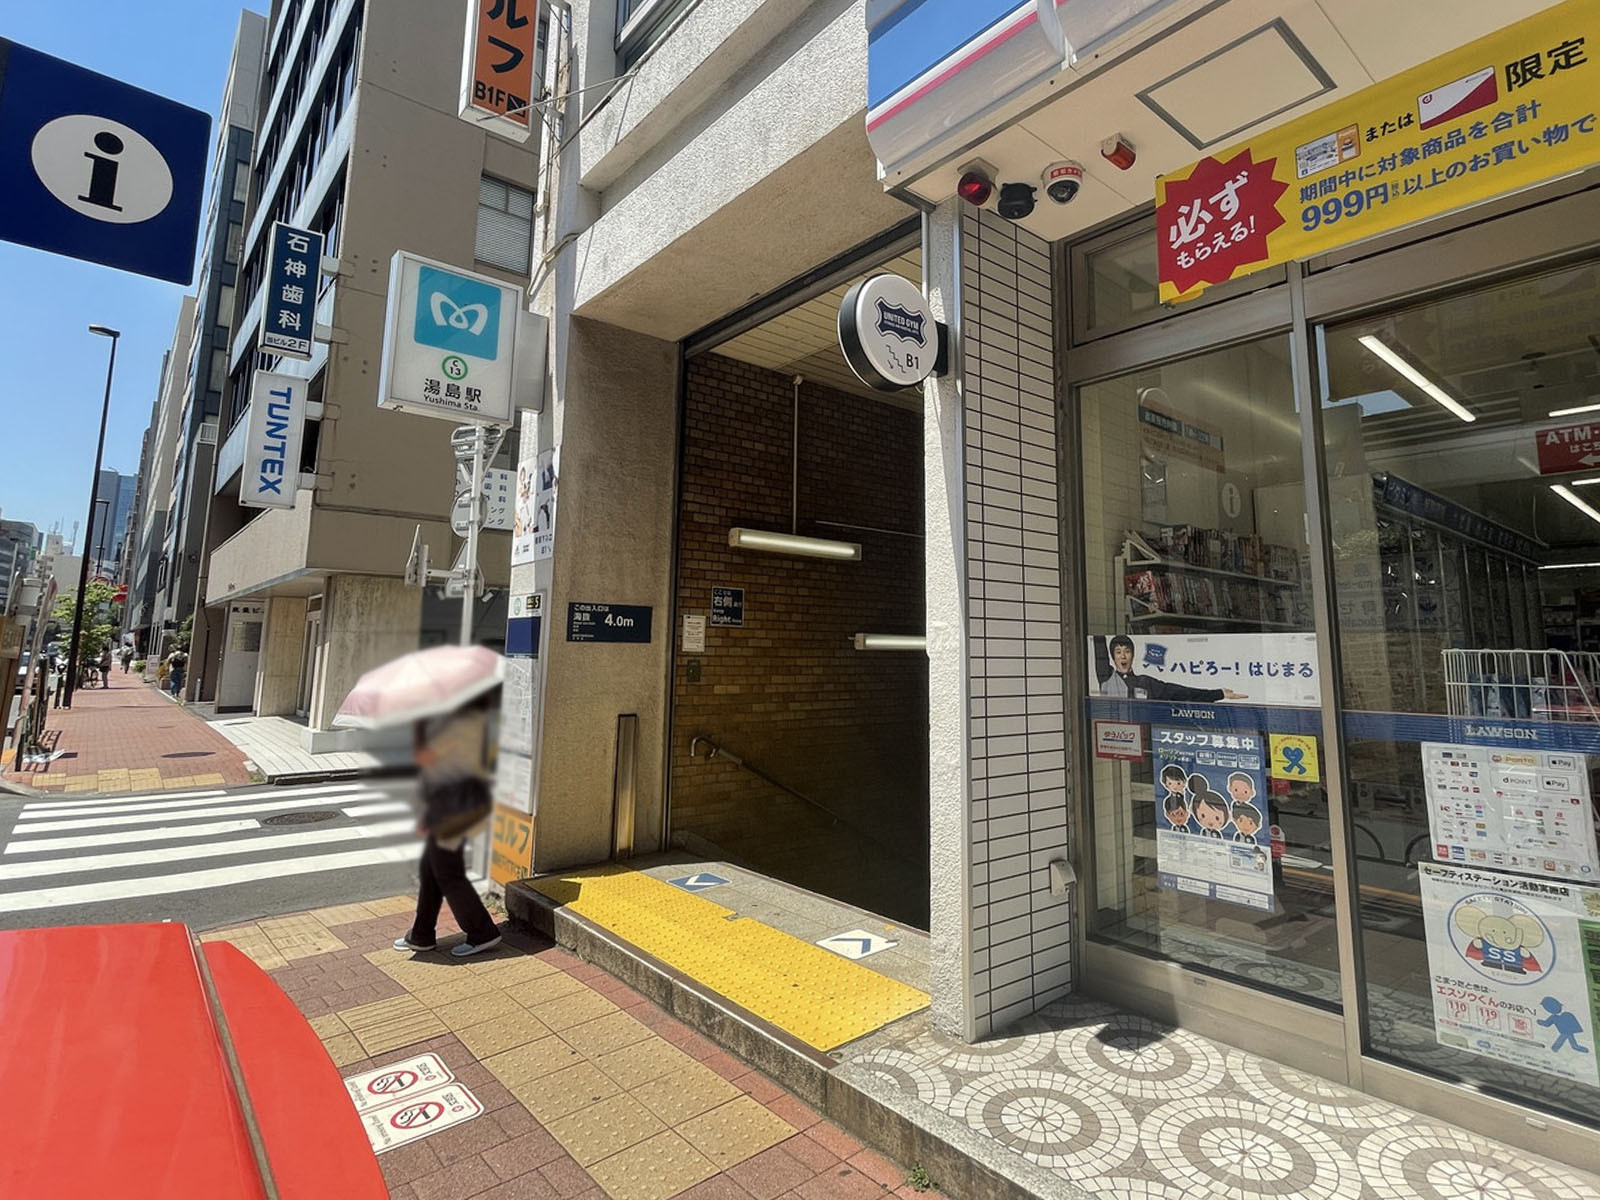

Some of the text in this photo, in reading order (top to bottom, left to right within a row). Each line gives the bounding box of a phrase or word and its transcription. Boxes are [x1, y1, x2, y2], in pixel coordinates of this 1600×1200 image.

[1504, 37, 1588, 92] 限定
[475, 80, 506, 107] B1F
[1365, 112, 1415, 142] または
[1300, 99, 1542, 204] 期間中に対象商品を合計
[1169, 170, 1249, 249] 必ず
[278, 232, 310, 331] 石神歯科
[883, 311, 905, 325] UNITED
[906, 353, 919, 369] B1
[449, 366, 462, 376] 13
[423, 378, 482, 403] 湯島駅
[424, 395, 461, 408] Yushima
[258, 387, 292, 495] TUNTEX
[604, 613, 634, 627] 4.0m
[1248, 661, 1314, 678] はじまる
[1171, 708, 1216, 720] LAWSON
[1465, 725, 1538, 740] LAWSON
[1160, 731, 1255, 751] スタッフ募集中
[1488, 947, 1516, 962] SS
[1448, 1000, 1467, 1012] 110
[1479, 1006, 1498, 1019] 119
